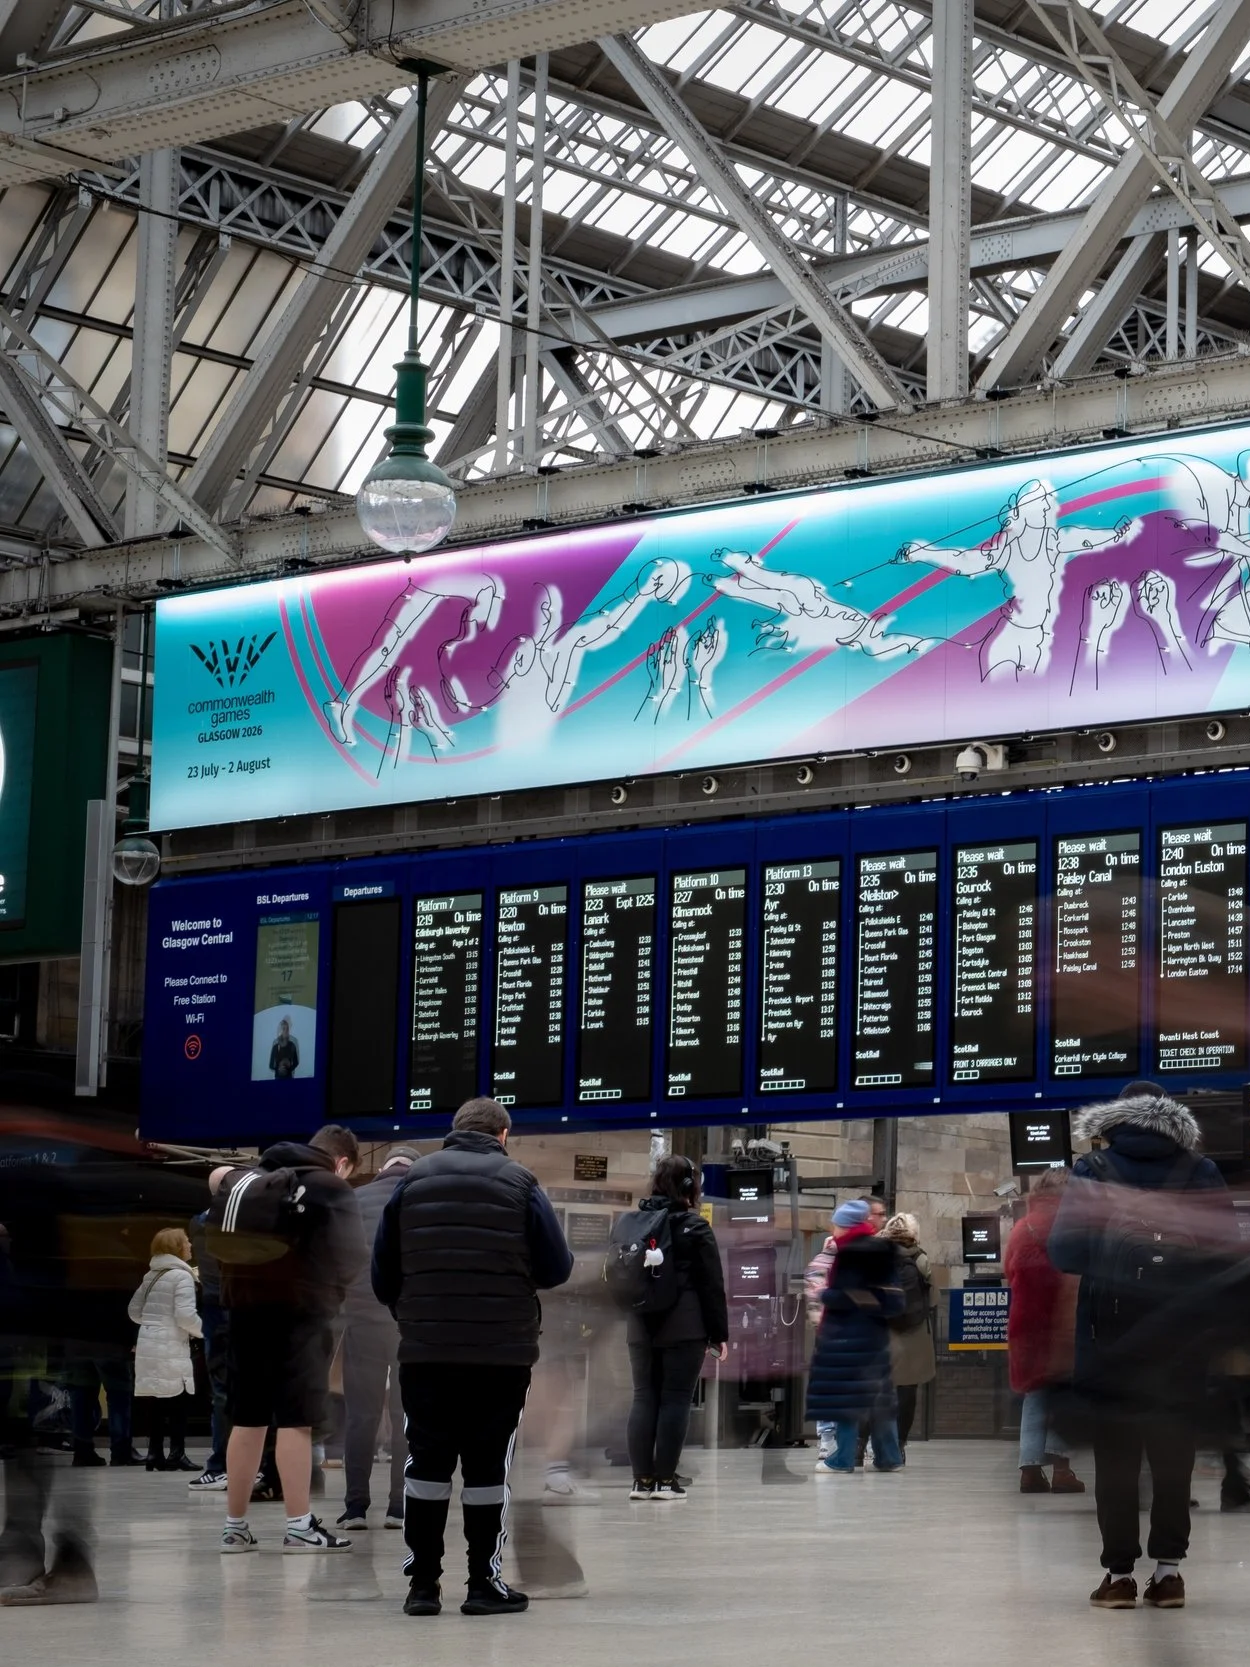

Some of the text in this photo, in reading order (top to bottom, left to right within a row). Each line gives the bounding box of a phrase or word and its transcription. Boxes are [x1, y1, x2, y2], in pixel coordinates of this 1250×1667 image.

[188, 689, 275, 714] commonwealth
[211, 709, 250, 728] games
[198, 725, 262, 743] GLASGOW 2026
[188, 757, 271, 779] 23 July 2 August
[1162, 847, 1184, 861] 12:40
[766, 865, 812, 880] Platform 13
[1161, 861, 1224, 876] London Euston
[674, 874, 719, 889] Platform 10
[1057, 869, 1112, 885] Paisley Canal
[344, 885, 382, 897] Departures
[957, 881, 991, 894] Gourock
[257, 892, 309, 904] BSL Departures
[500, 891, 539, 904] Platform 9
[417, 898, 454, 912] Platform 7
[673, 904, 712, 918] Kilmarnock
[764, 899, 779, 911] Ayr
[172, 918, 222, 932] Welcome to
[584, 913, 610, 925] Lanark
[416, 926, 470, 937] Edinburgh Waverley
[498, 921, 525, 933] Newton
[162, 932, 233, 949] Glasgow Central
[164, 974, 227, 987] Please Connect to
[174, 994, 216, 1006] Free Station
[186, 1013, 204, 1024] Wi-Fi
